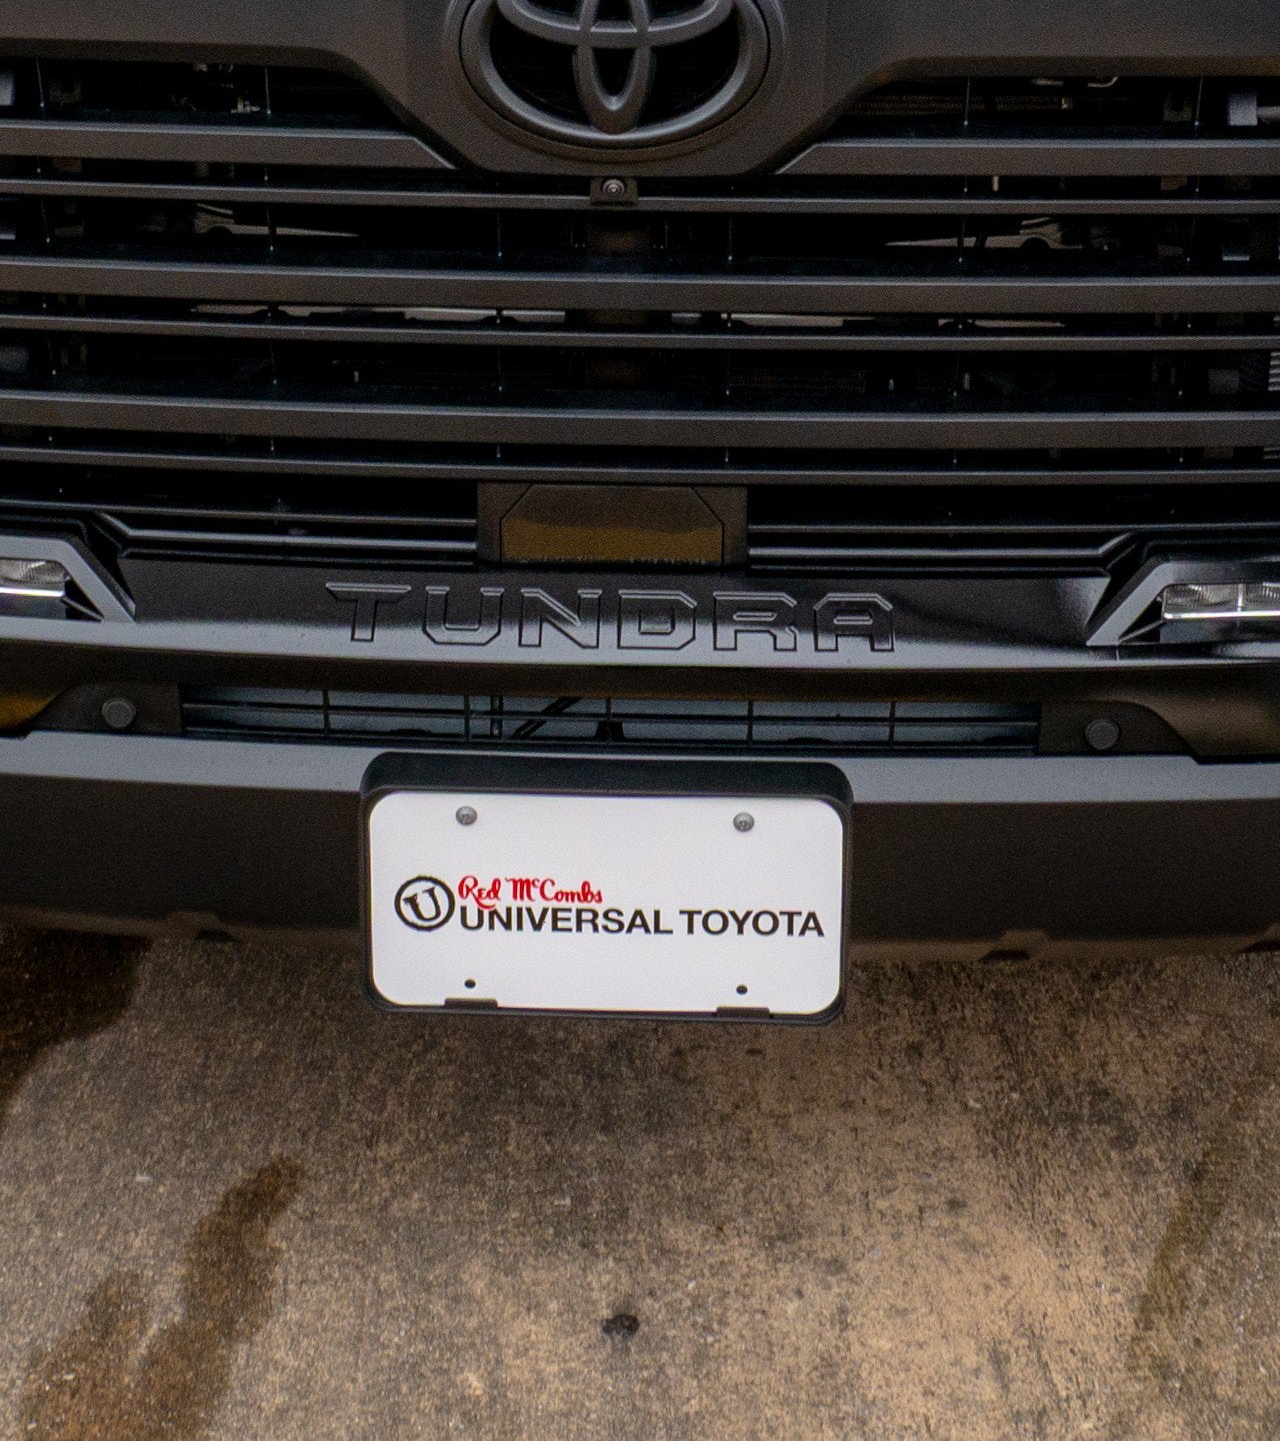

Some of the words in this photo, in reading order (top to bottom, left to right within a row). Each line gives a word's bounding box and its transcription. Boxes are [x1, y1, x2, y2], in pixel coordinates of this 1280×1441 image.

[325, 582, 895, 652] TUNDRA
[458, 876, 501, 909] Red
[505, 878, 603, 904] McCombs
[460, 906, 674, 935] UNIVERSAL
[679, 910, 825, 937] TOYOTA
